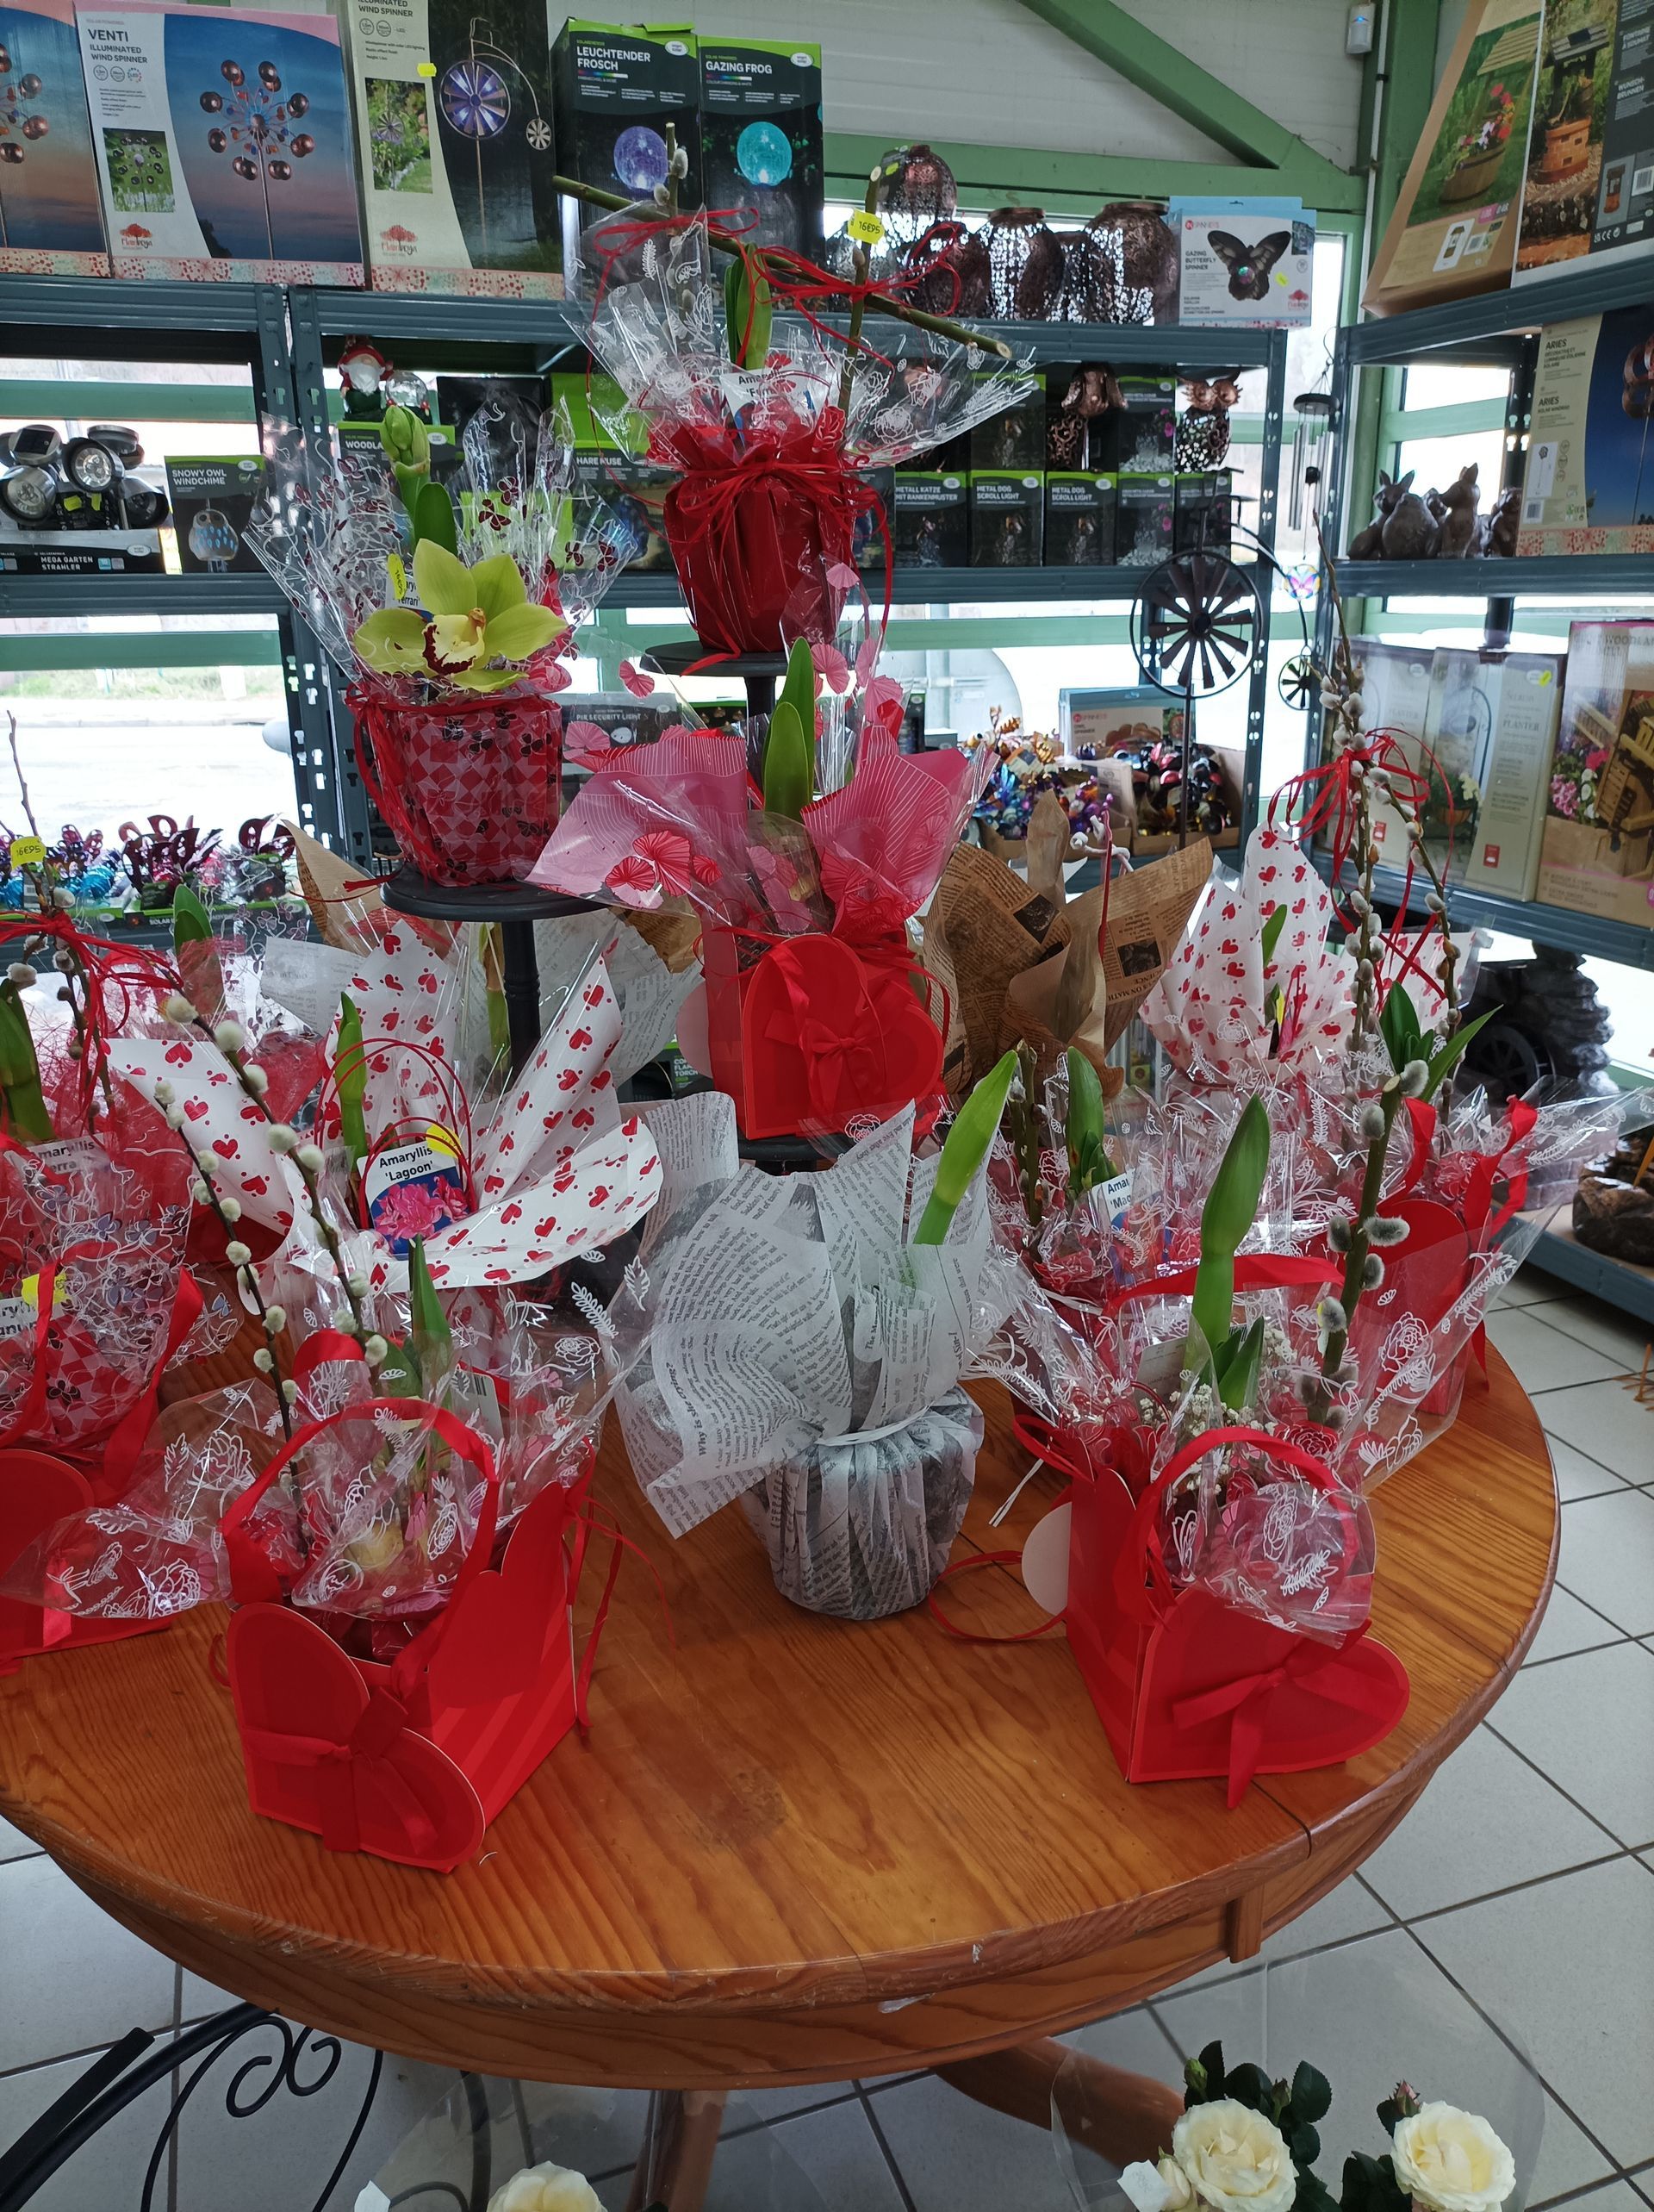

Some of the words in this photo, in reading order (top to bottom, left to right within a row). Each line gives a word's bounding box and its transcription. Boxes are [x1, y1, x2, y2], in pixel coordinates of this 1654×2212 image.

[358, 5, 380, 14] WIND
[381, 8, 414, 17] SPINNER
[88, 28, 129, 41] VENTI
[90, 44, 141, 53] ILLUMINATED
[576, 46, 651, 62] LEUCHTENDER
[114, 55, 148, 64] SPINNER
[577, 58, 619, 71] FROSCH
[706, 60, 744, 72] GAZING
[745, 63, 773, 74] FROG
[859, 221, 880, 234] 16€95
[1545, 339, 1568, 350] ARIES
[1539, 396, 1559, 407] ARIES
[172, 469, 205, 477] SNOWY
[206, 469, 227, 477] OWL
[173, 477, 226, 486] WINDCHIME
[1502, 720, 1539, 732] PLANTER
[379, 1146, 433, 1168] Amaryllis
[385, 1161, 433, 1182] 'Lagoon'
[867, 1334, 876, 1350] The
[664, 1361, 687, 1401] crying?
[683, 1399, 698, 1418] she
[694, 1418, 703, 1430] is
[697, 1430, 707, 1456] Why
